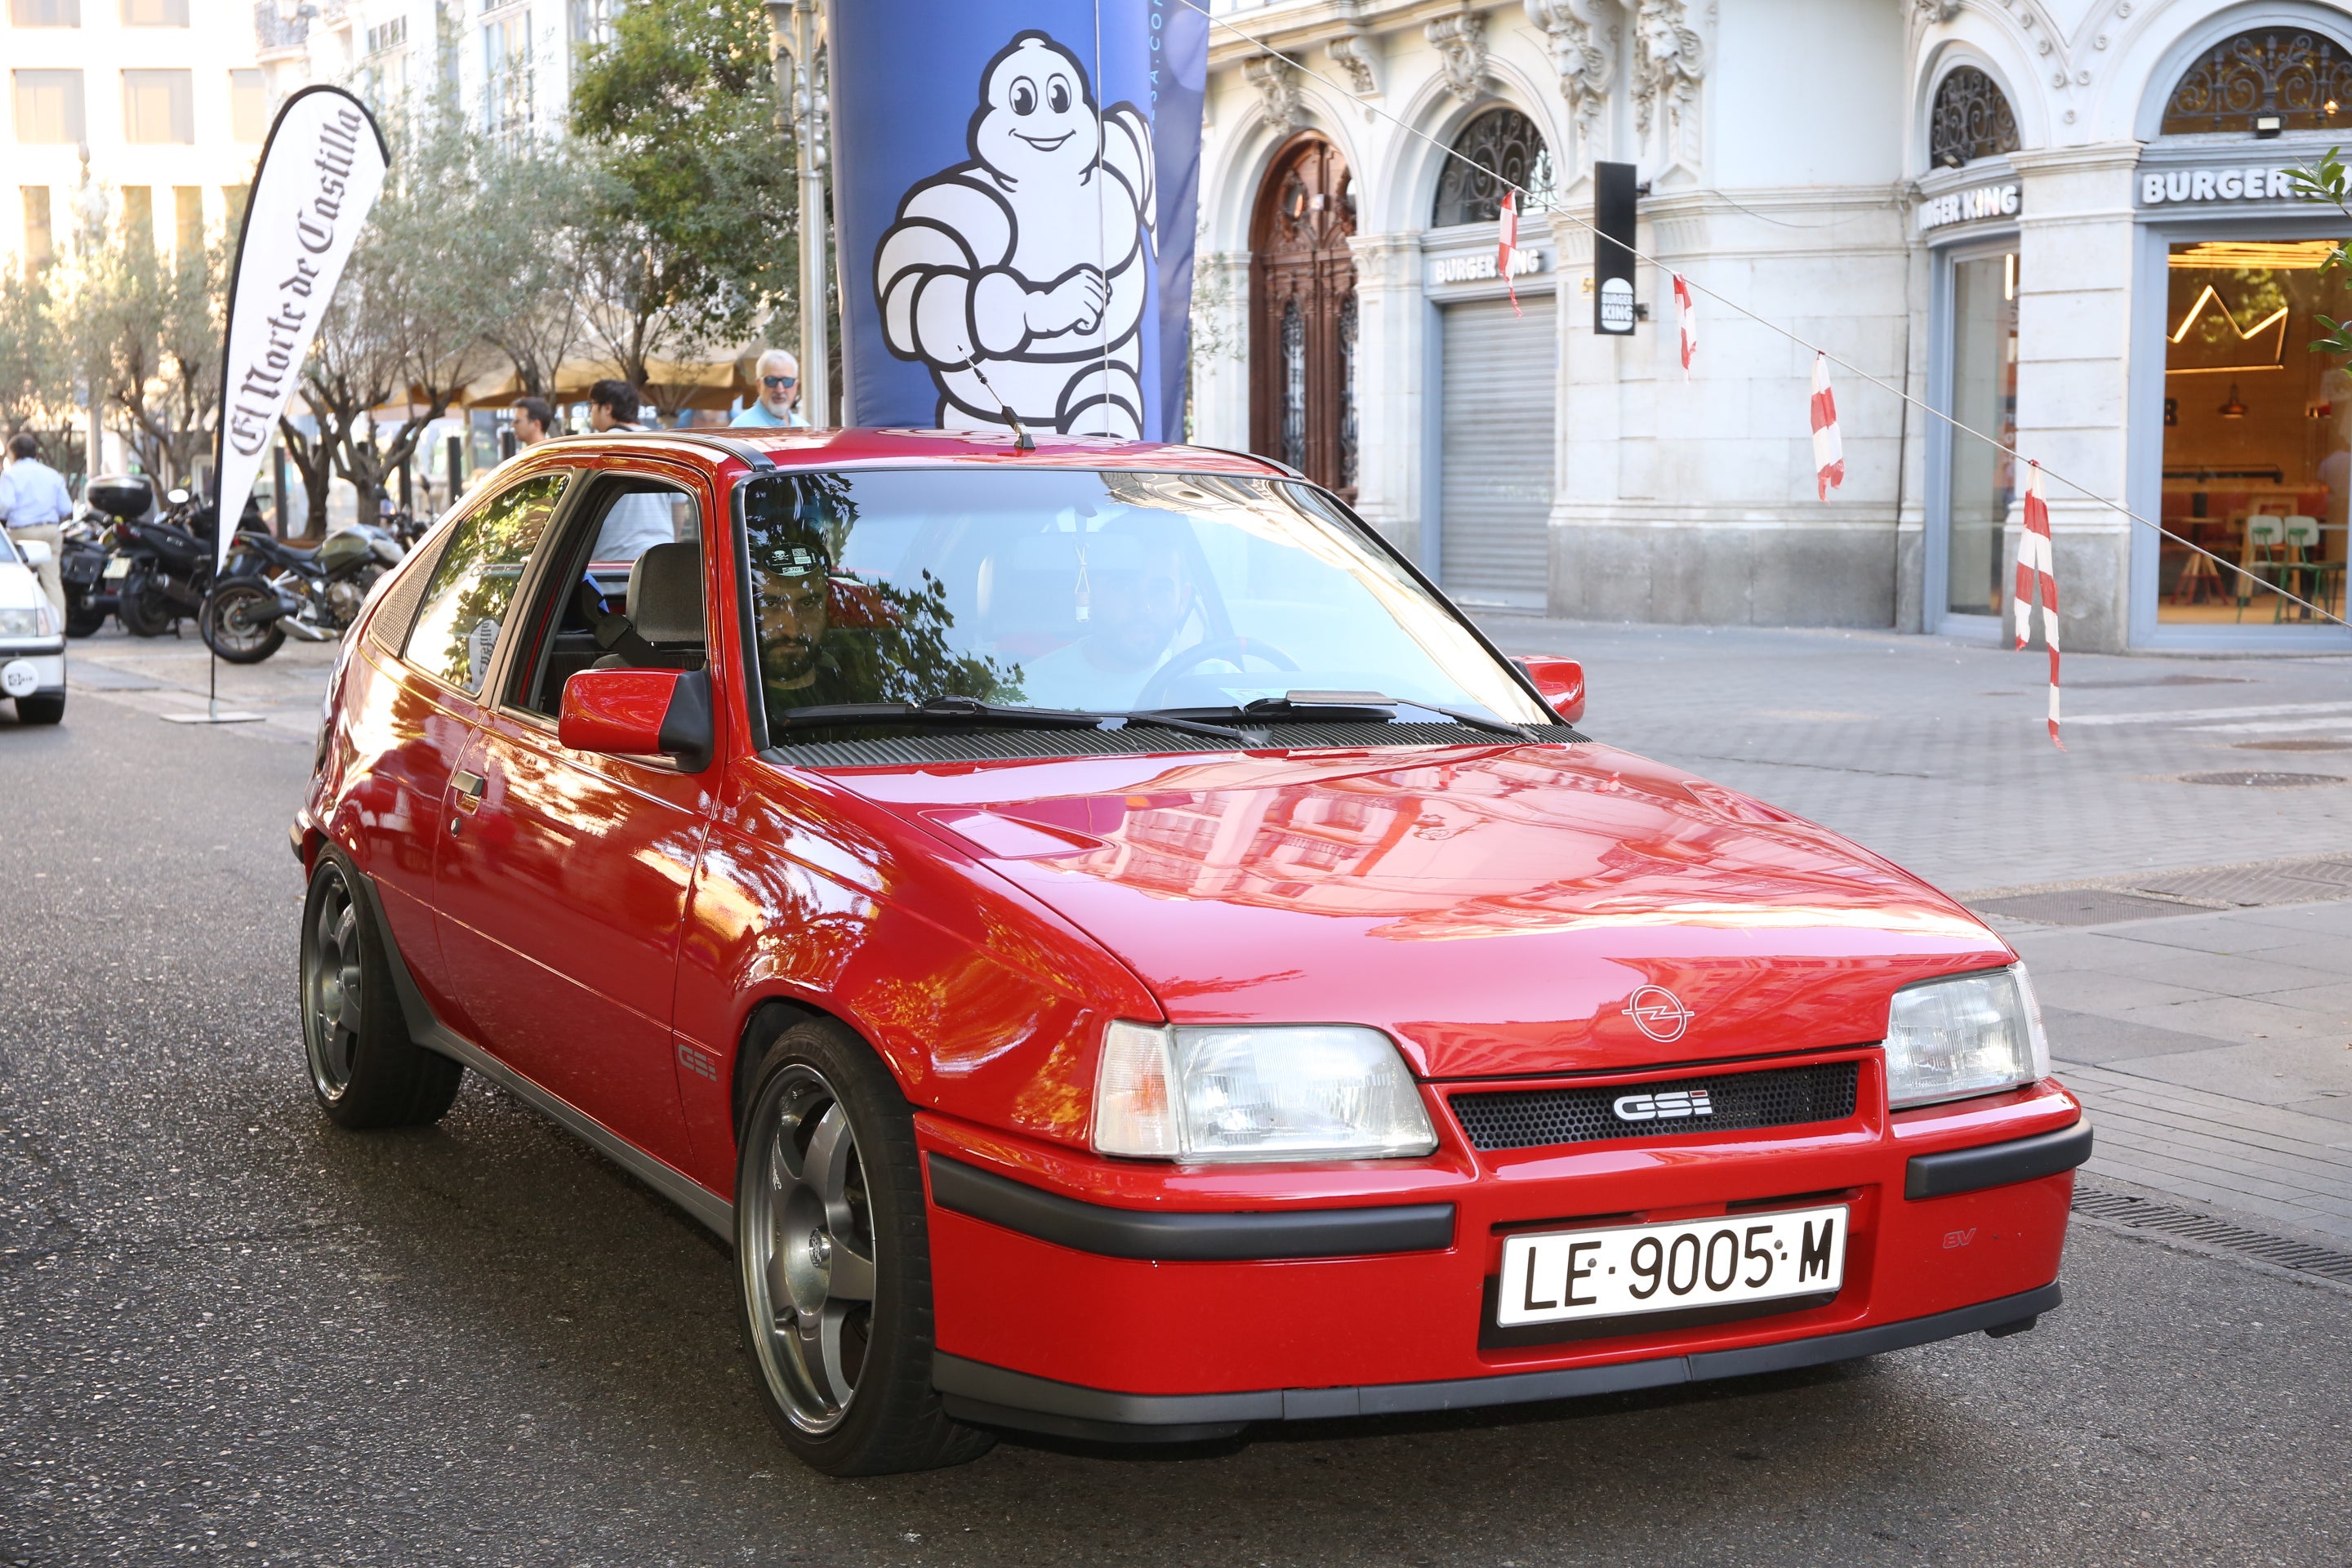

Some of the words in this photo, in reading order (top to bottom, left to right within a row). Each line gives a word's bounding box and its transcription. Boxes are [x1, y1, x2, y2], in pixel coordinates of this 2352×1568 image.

[296, 109, 362, 254] Castilla
[2142, 167, 2292, 205] BURGER
[1962, 185, 2018, 220] KING
[279, 257, 320, 298] de
[1435, 255, 1497, 283] BURGER
[1601, 293, 1634, 305] BURGER
[1601, 303, 1633, 321] KING
[241, 302, 307, 399] Norte
[229, 405, 271, 456] El
[1943, 1227, 1977, 1249] 8V
